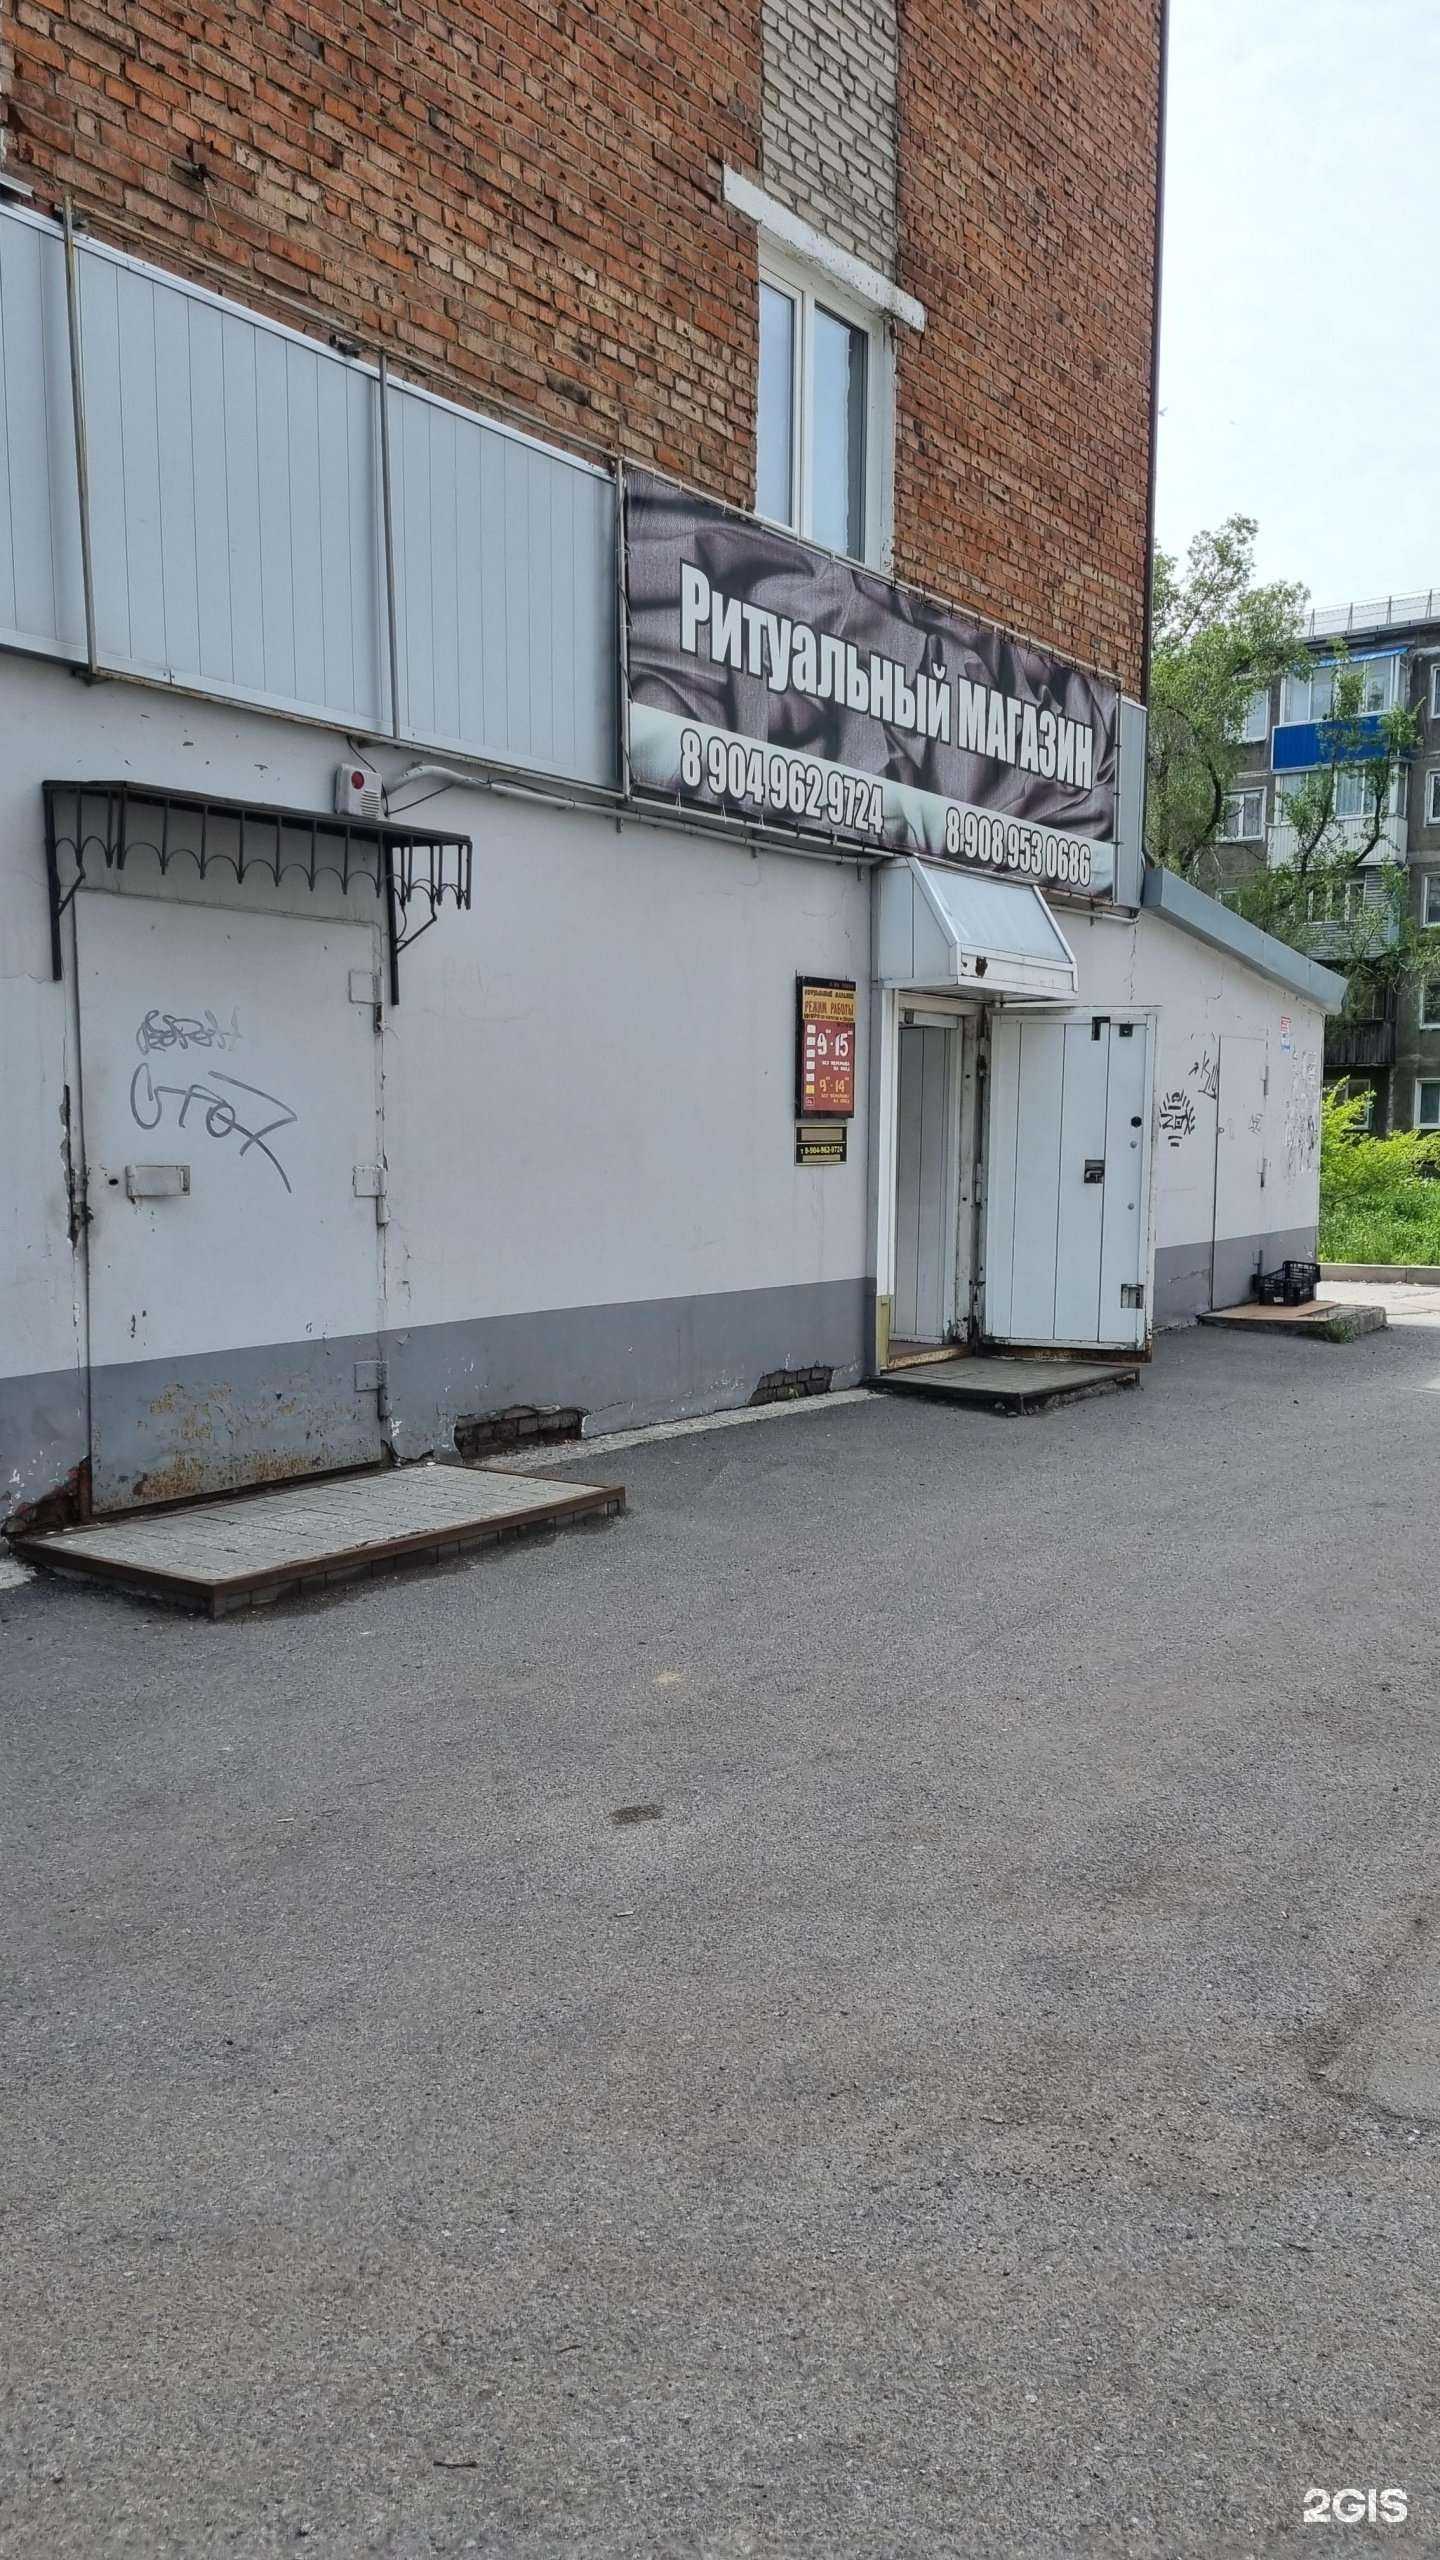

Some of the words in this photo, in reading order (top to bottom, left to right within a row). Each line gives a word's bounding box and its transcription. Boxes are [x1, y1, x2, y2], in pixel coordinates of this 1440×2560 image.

[680, 557, 952, 746] Ритуальный
[957, 673, 1094, 792] МАГАЗИН
[680, 728, 702, 787] 8
[706, 736, 765, 805] 904
[768, 754, 823, 819] 962
[826, 771, 884, 835] 9724
[945, 806, 961, 854] 8
[963, 812, 1005, 865] 908
[1006, 824, 1044, 876] 953
[1045, 834, 1092, 887] 0686
